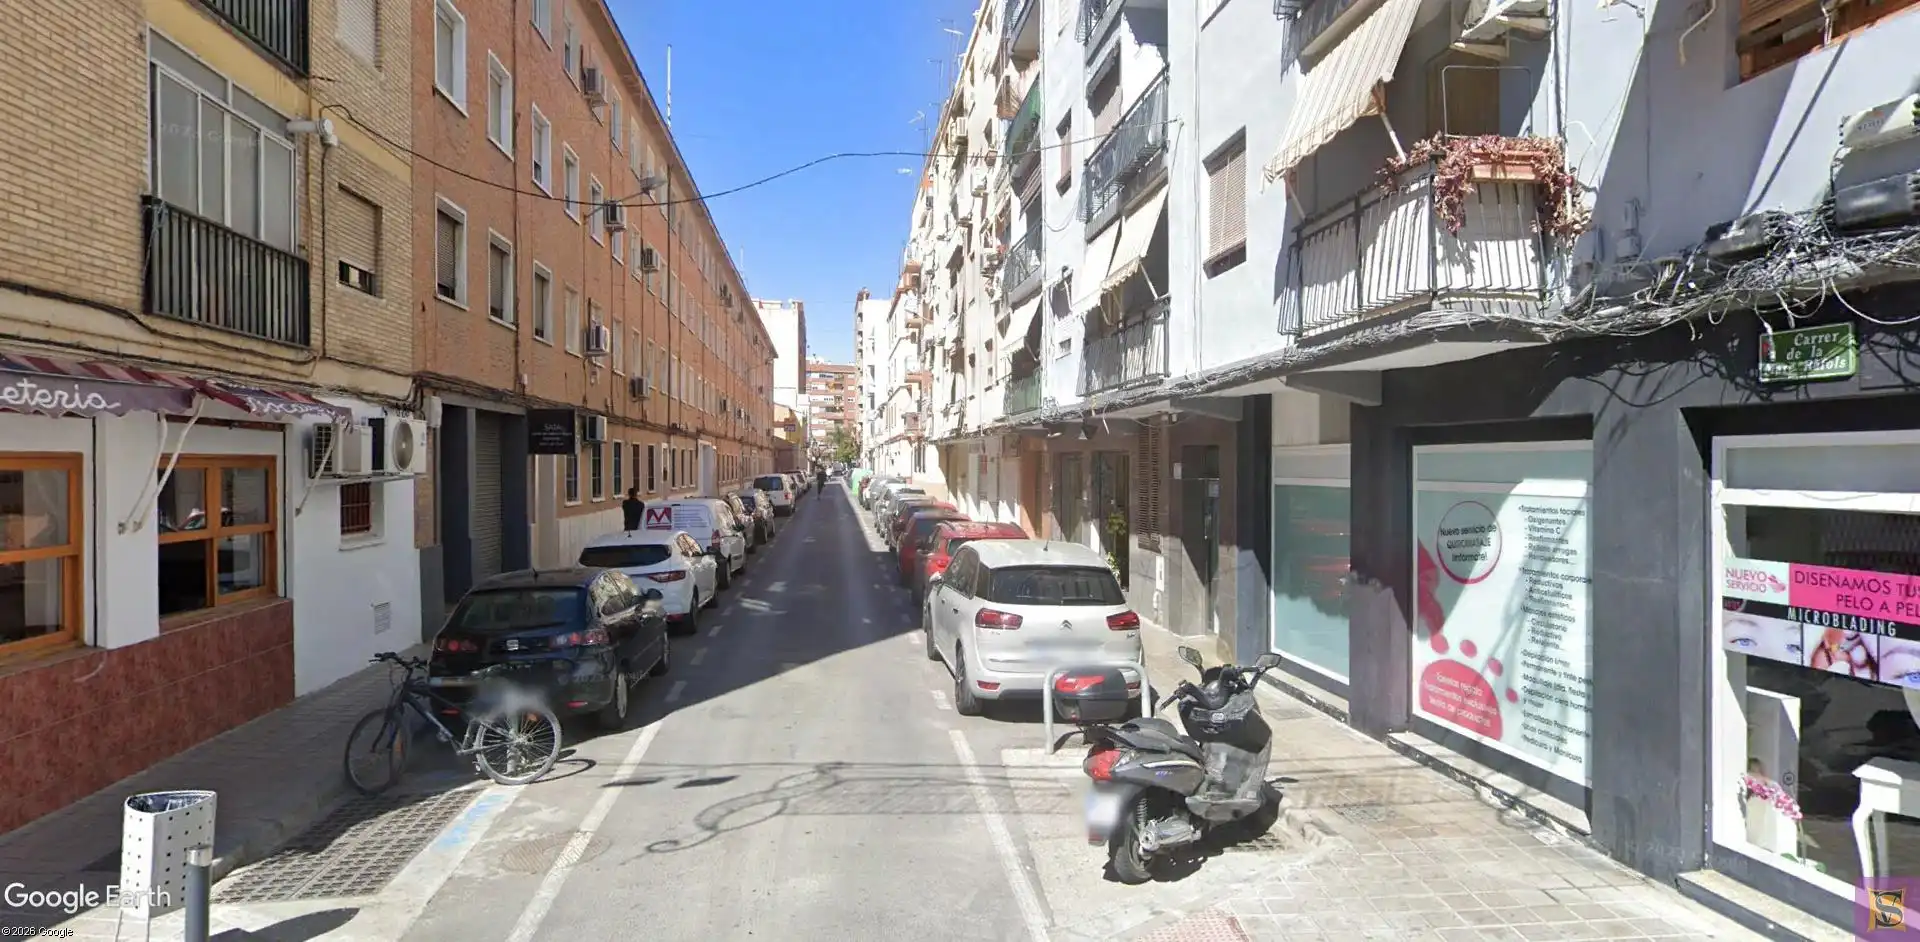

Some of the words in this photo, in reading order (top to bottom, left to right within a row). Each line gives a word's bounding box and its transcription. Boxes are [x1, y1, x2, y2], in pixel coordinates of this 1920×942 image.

[1794, 332, 1839, 346] Carrer
[1786, 347, 1802, 360] de
[1810, 345, 1823, 358] la
[1486, 523, 1497, 533] de
[1725, 568, 1768, 582] NUEVO
[1726, 579, 1767, 593] SERVICIO
[1837, 593, 1874, 611] PELO
[1879, 600, 1891, 613] A
[1787, 606, 1897, 637] MICROBLADING
